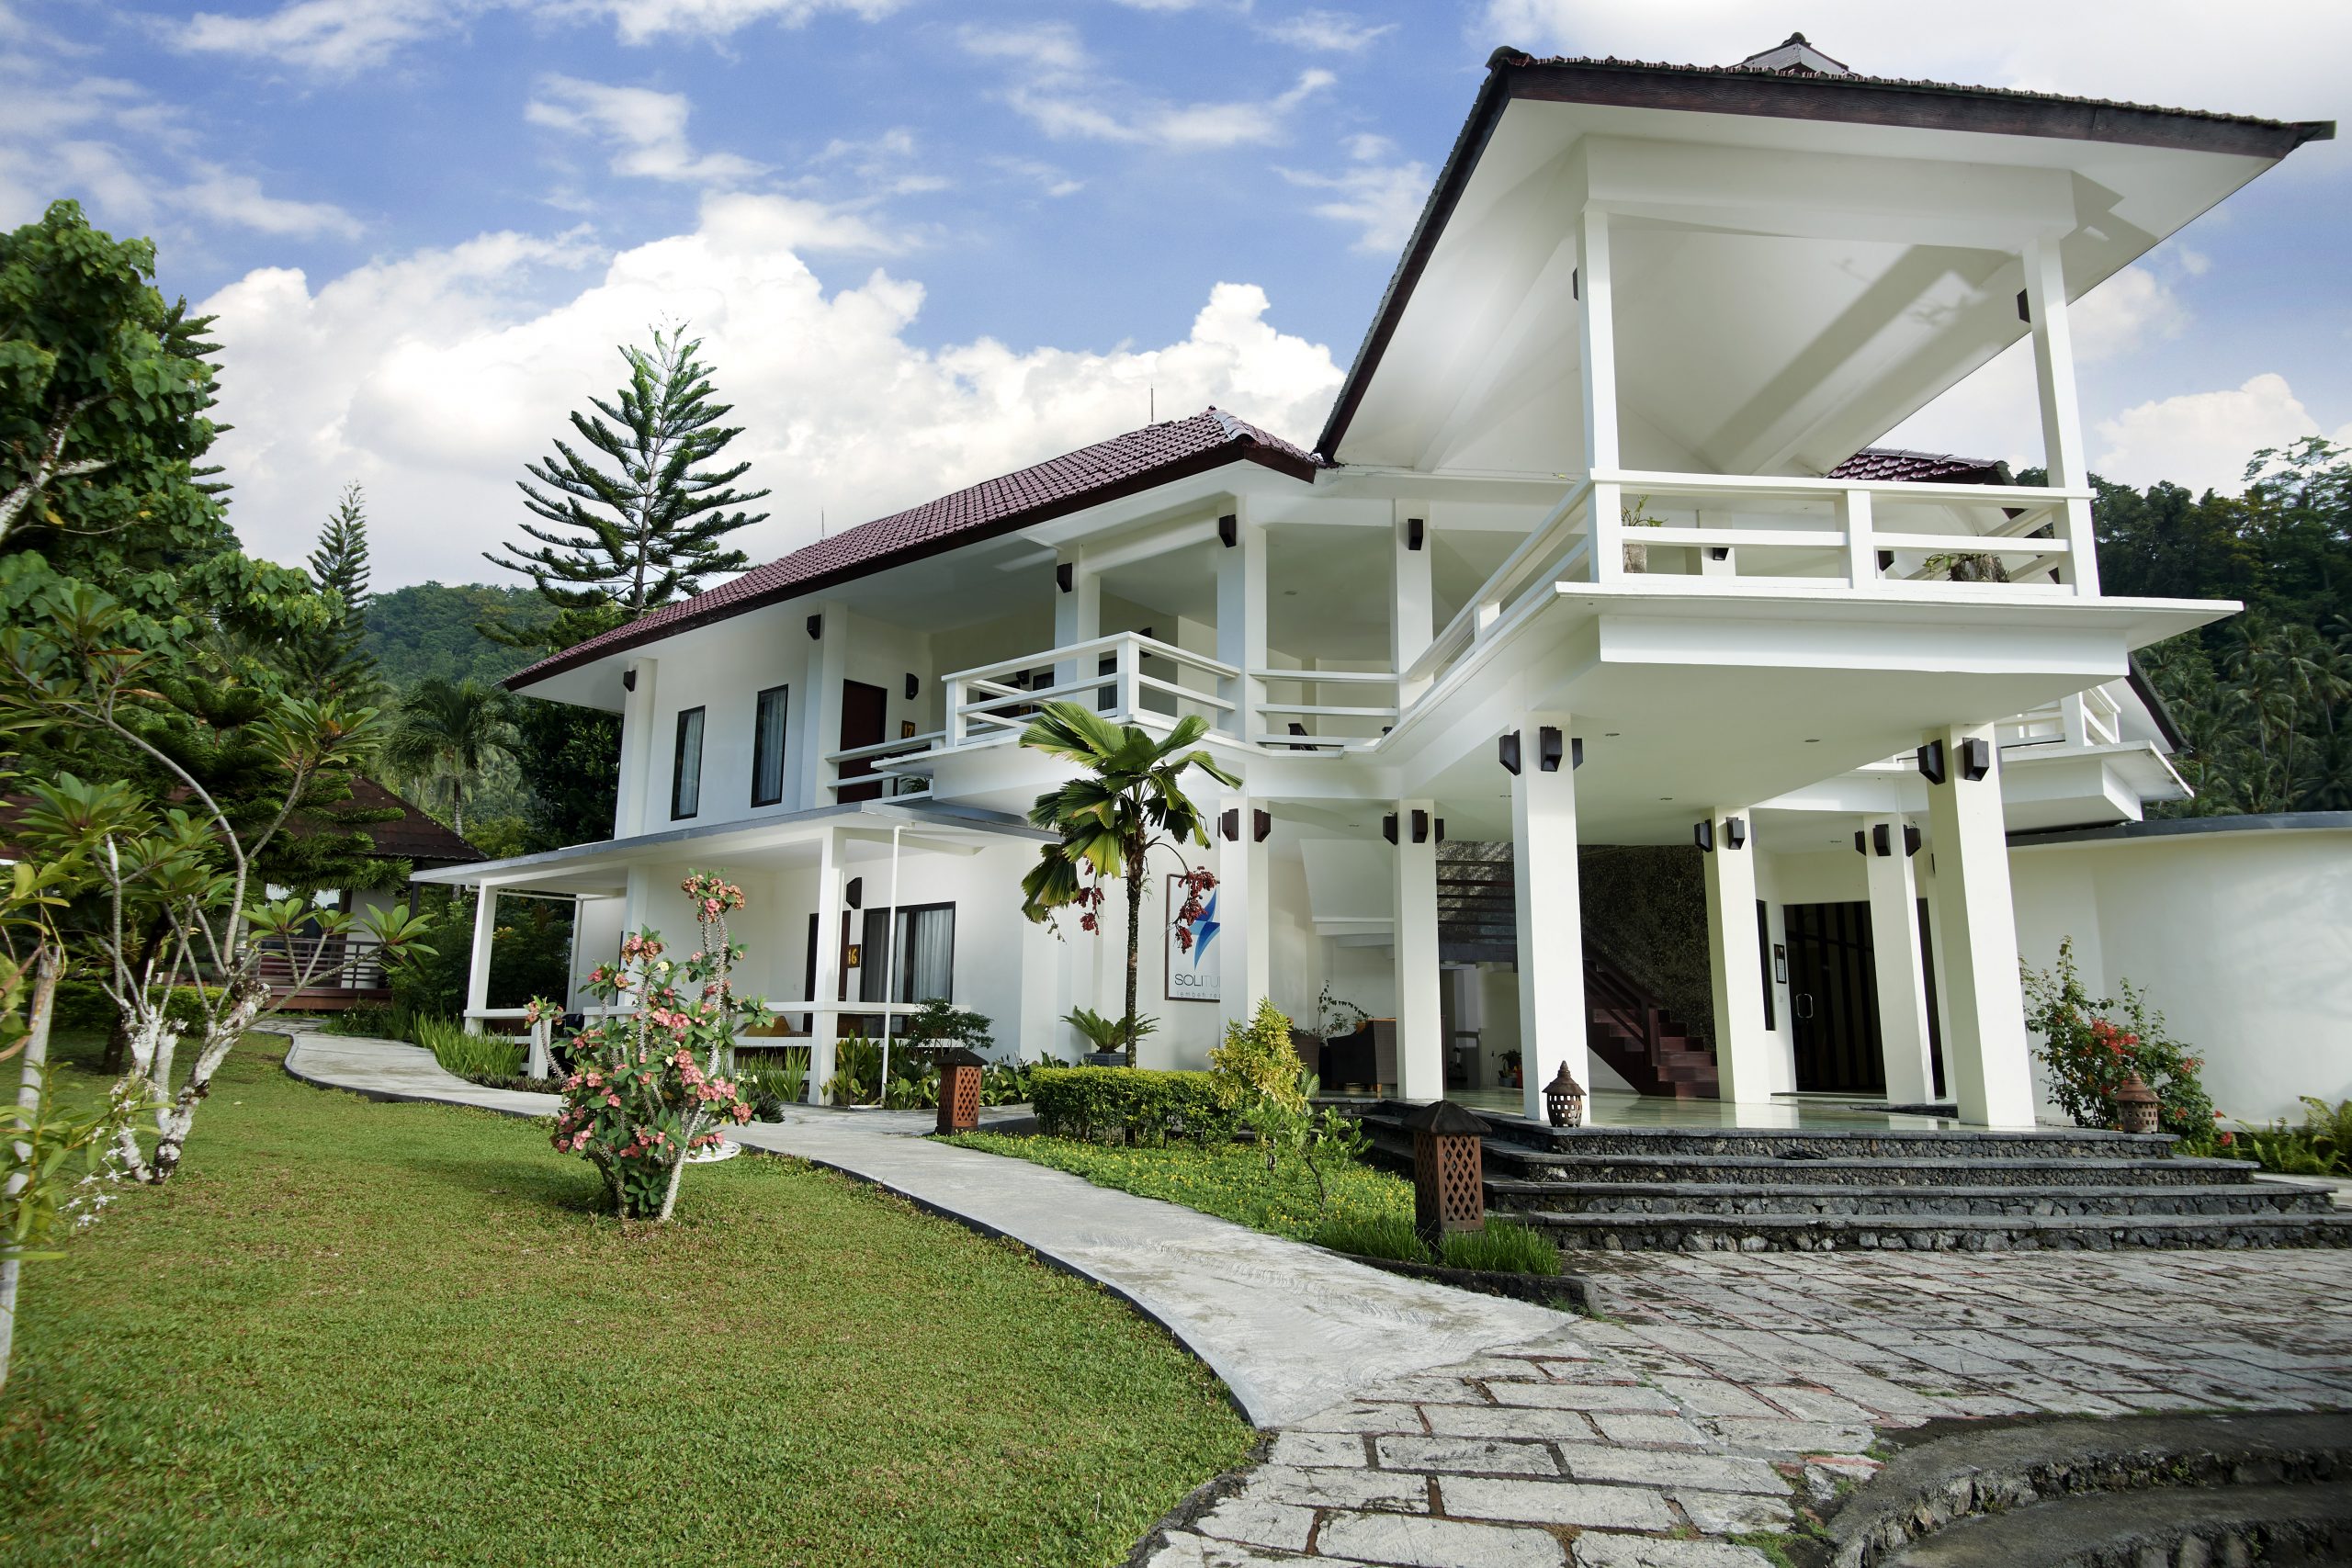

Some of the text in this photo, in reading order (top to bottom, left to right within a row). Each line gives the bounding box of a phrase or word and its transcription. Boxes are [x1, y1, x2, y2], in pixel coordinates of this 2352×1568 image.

[904, 724, 914, 738] 17
[848, 948, 857, 964] 16
[1174, 974, 1220, 987] SOLITU
